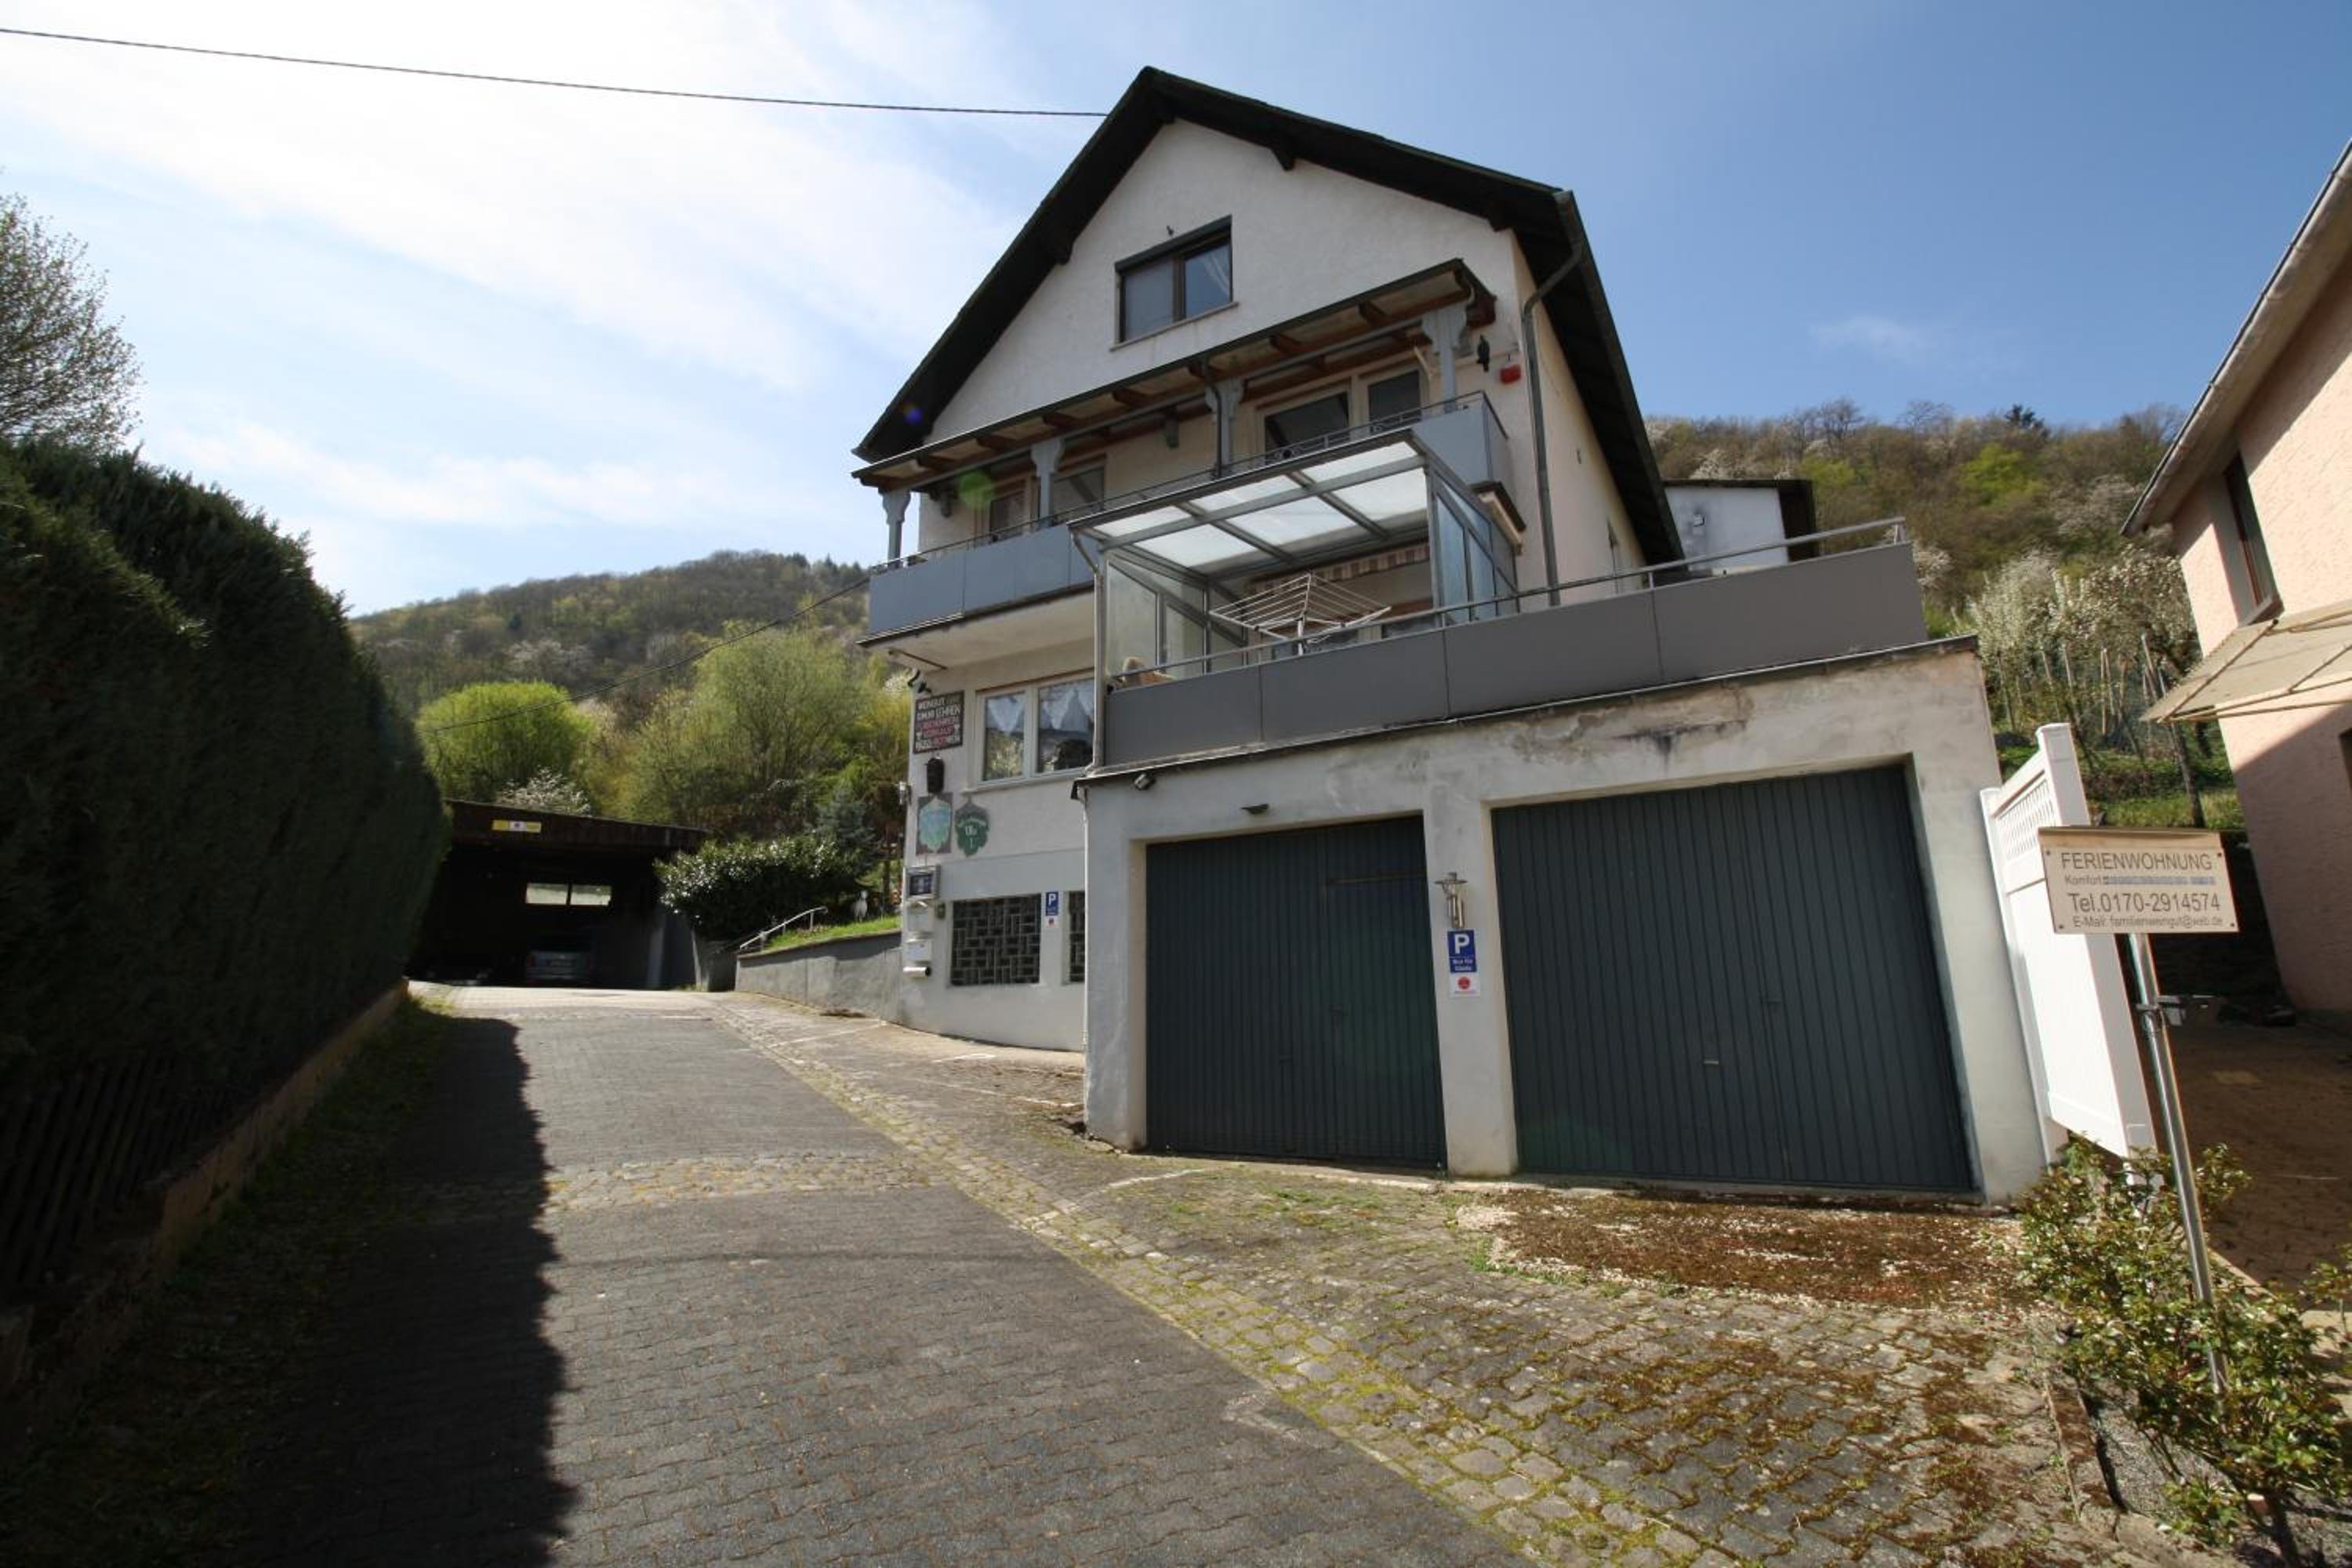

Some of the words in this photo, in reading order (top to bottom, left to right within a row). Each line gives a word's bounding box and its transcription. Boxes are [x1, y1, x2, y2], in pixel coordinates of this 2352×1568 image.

[2060, 852, 2212, 870] FERIENWOHNUNG
[1048, 893, 1056, 906] P
[2067, 893, 2220, 913] Tel.0170-2914574
[1454, 934, 1470, 954] P
